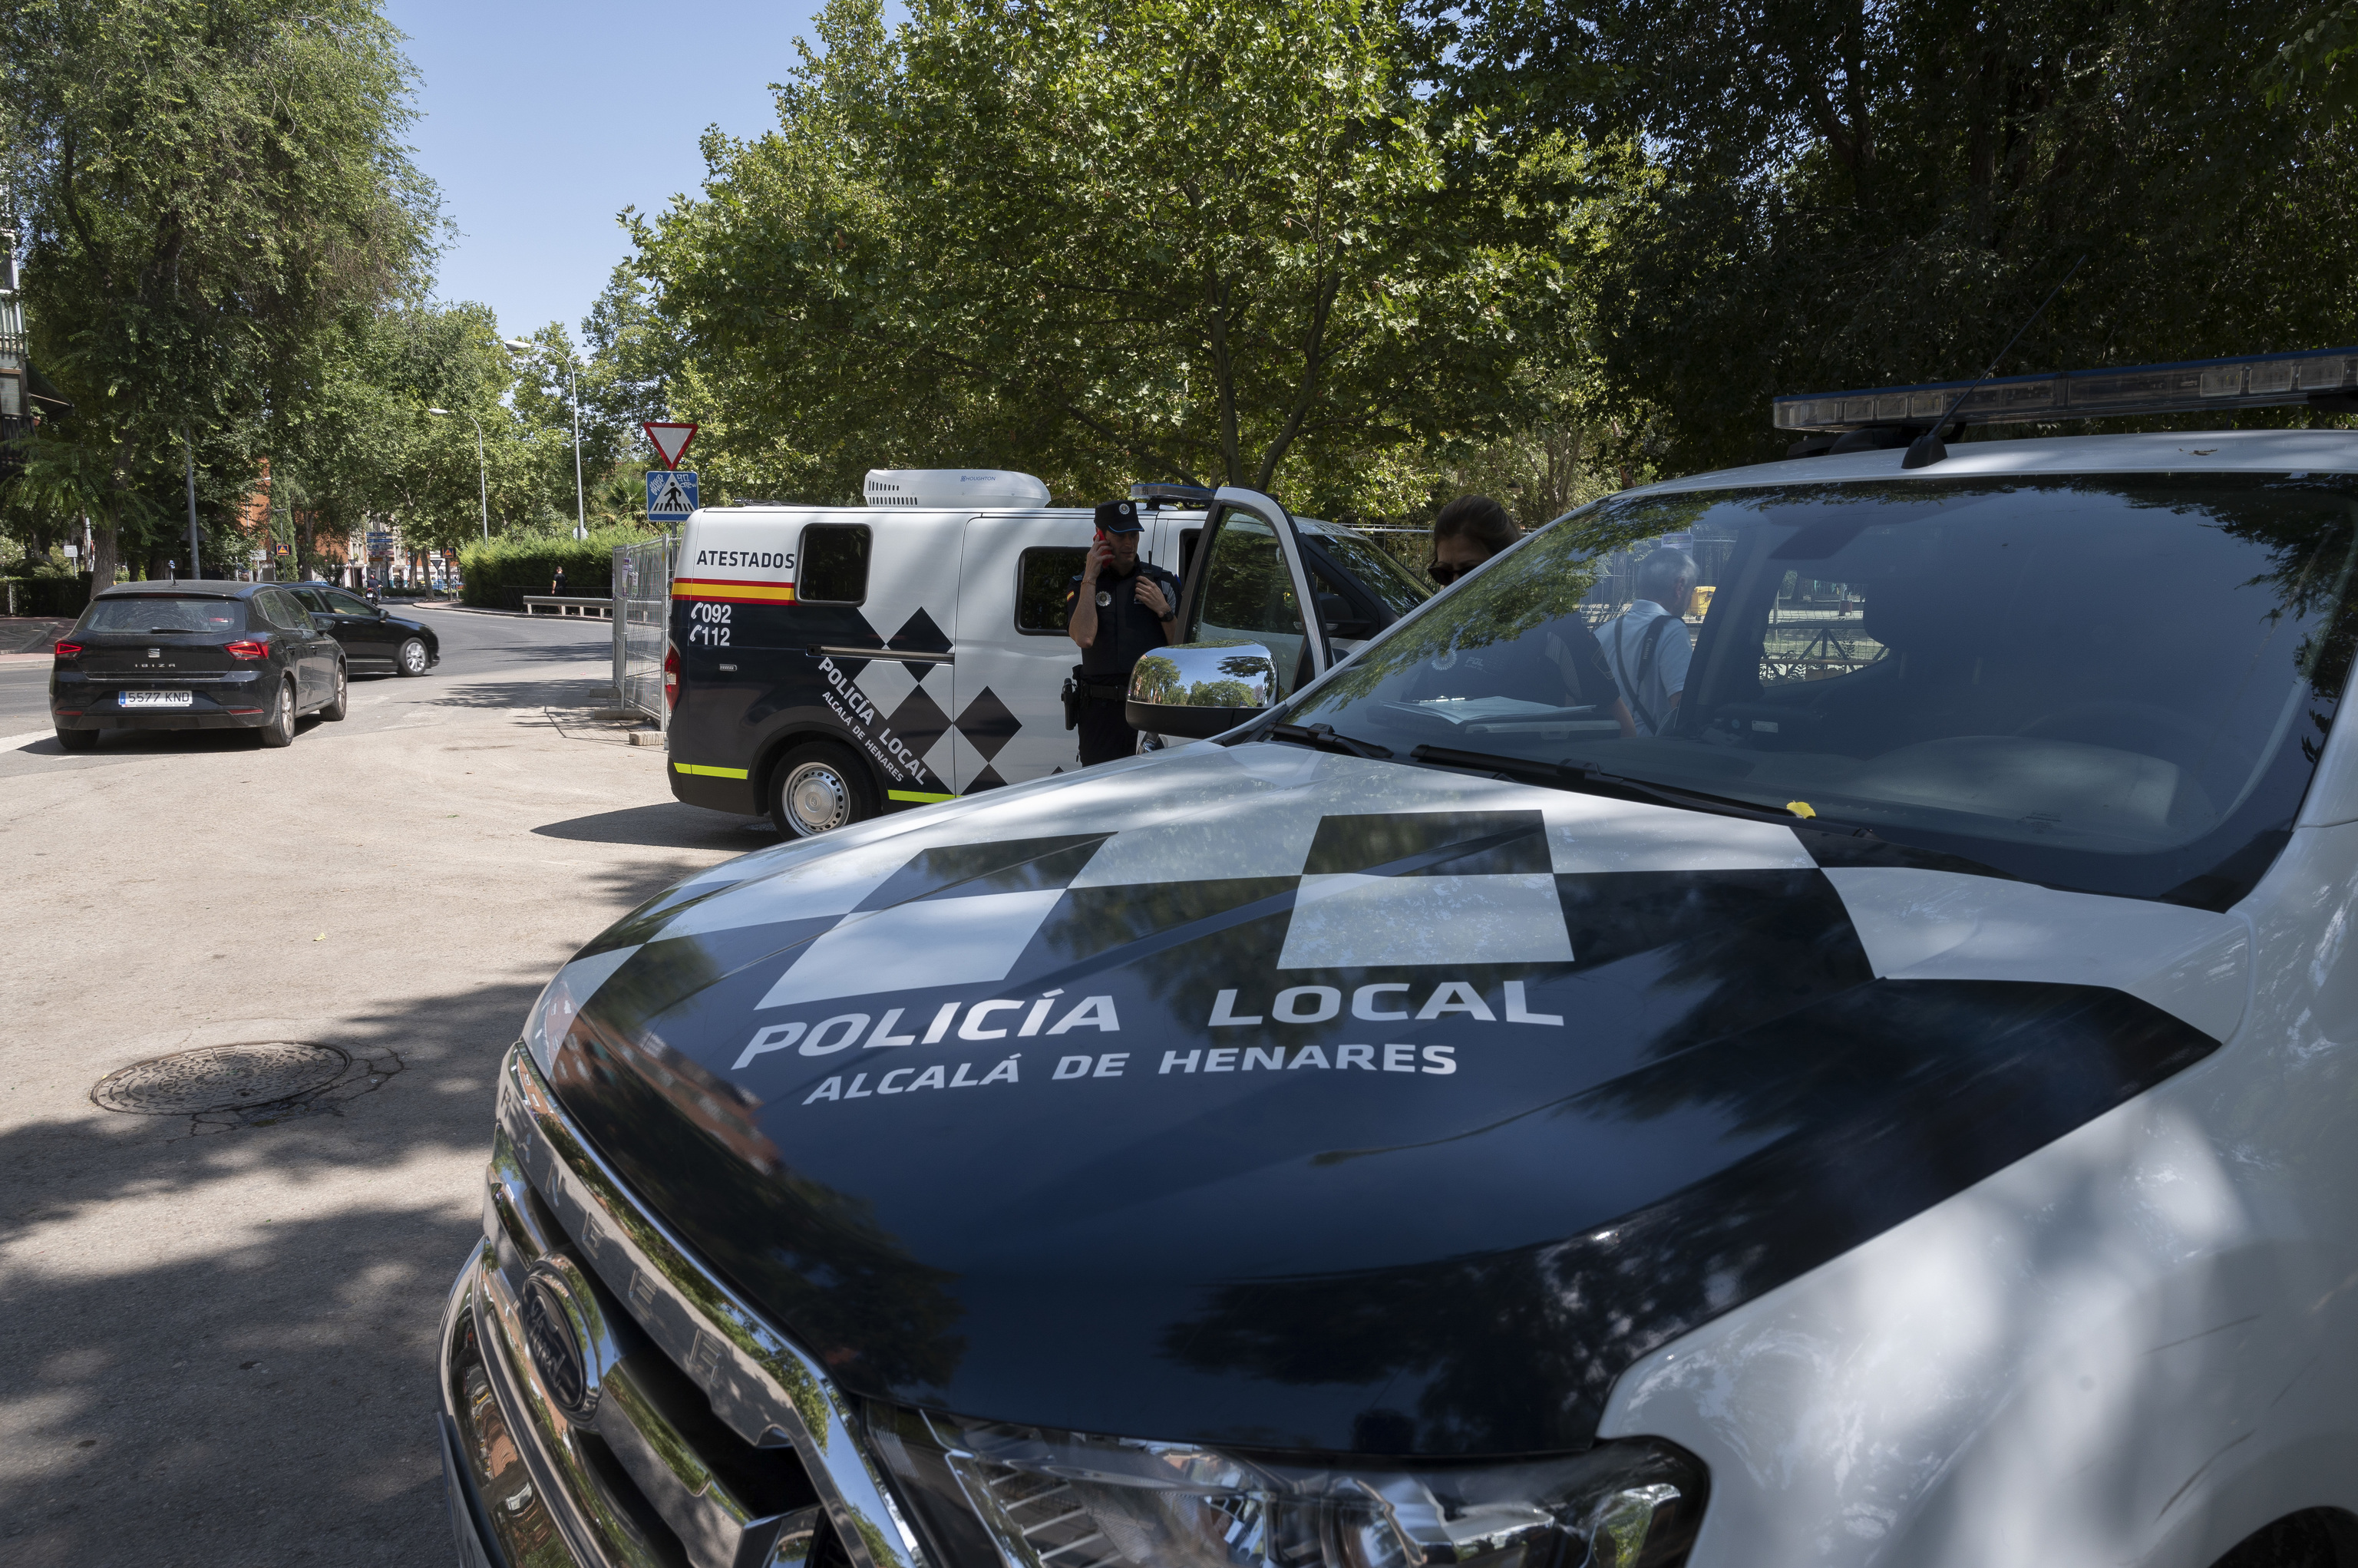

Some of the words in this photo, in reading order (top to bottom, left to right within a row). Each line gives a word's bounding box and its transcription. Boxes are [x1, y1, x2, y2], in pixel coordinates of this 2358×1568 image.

[696, 550, 795, 569] ATESTADOS
[702, 603, 732, 624] 092
[702, 626, 731, 646] 112
[128, 692, 161, 703] 5577
[165, 692, 190, 702] KND
[817, 656, 875, 726] POLICÍA
[878, 727, 927, 786] LOCAL
[822, 691, 854, 727] ALCALÁ
[852, 725, 866, 741] DE
[864, 739, 904, 782] HENARES
[731, 989, 1121, 1071] POLICÍA
[1207, 980, 1564, 1027] LOCAL
[801, 1052, 1022, 1106] ALCALÁ
[1052, 1052, 1131, 1081] DE
[1158, 1043, 1458, 1075] HENARES
[526, 1295, 566, 1388] Ford
